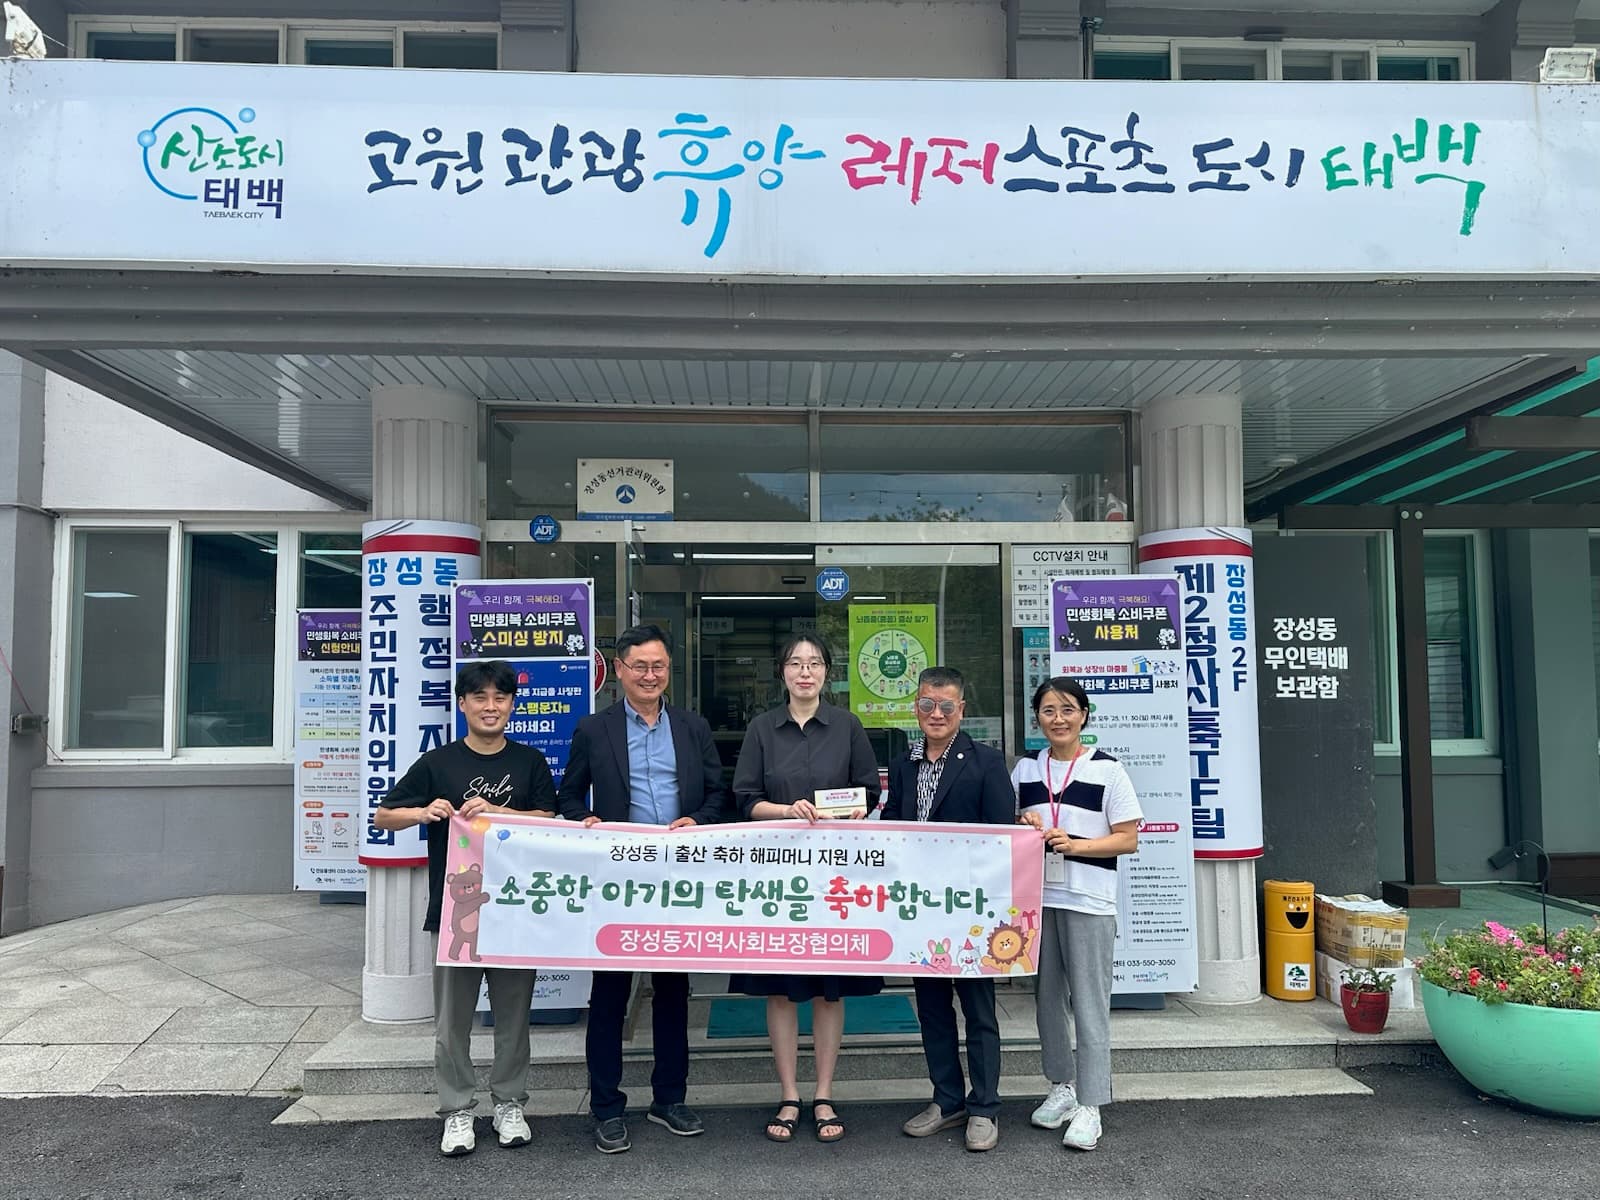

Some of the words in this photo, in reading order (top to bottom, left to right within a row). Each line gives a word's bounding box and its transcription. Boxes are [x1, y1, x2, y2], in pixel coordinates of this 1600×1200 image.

[161, 124, 284, 173] 산소도시
[365, 130, 484, 192] 고원
[501, 123, 645, 194] 관광
[653, 113, 826, 258] 휴양
[845, 134, 999, 205] 레저
[1003, 111, 1176, 193] 스포츠
[1188, 136, 1305, 192] 도시
[1320, 117, 1486, 237] 태백
[203, 178, 284, 219] 태백
[203, 211, 243, 219] TAEBAEK
[584, 466, 667, 496] 장성동선거관리위원회
[535, 525, 554, 536] ADT
[1033, 550, 1084, 562] CCTV설치
[1087, 550, 1108, 562] 안내
[368, 557, 458, 587] 장성동
[822, 578, 845, 590] ADT
[483, 595, 501, 605] 우리
[504, 594, 523, 605] 함께,
[526, 594, 563, 604] 극복해요!
[1082, 595, 1098, 605] 우리
[1118, 594, 1151, 604] 극복해요!
[1225, 563, 1248, 642] 장성동
[469, 612, 522, 628] 민생회복
[524, 611, 577, 627] 소비쿠폰
[1066, 607, 1116, 622] 민생회복
[1118, 606, 1168, 621] 소비쿠폰
[306, 631, 339, 641] 민생회복
[1094, 624, 1139, 640] 사용처
[1273, 617, 1338, 641] 장성동
[481, 630, 529, 647] 스미싱
[532, 629, 563, 646] 방지
[321, 642, 361, 654] 신청안내
[1264, 646, 1348, 670] 무인택배
[1062, 665, 1083, 674] 회복과
[1084, 665, 1105, 674] 성장의
[532, 687, 556, 697] 지급을
[1108, 678, 1151, 690] 소비쿠폰
[1154, 679, 1179, 688] 사용처
[1276, 675, 1339, 699] 보관함
[463, 773, 514, 801] Smile
[609, 845, 659, 862] 장성동
[675, 844, 708, 864] 출산
[712, 846, 745, 865] 축하
[749, 847, 812, 866] 해피머니
[817, 848, 849, 867] 지원
[853, 850, 886, 868] 사업
[495, 871, 593, 915] 소중한
[601, 879, 705, 910] 아기의
[715, 876, 815, 922] 탄생을
[823, 875, 996, 921] 축하합니다.
[619, 929, 870, 956] 장성동지역사회보장협의체
